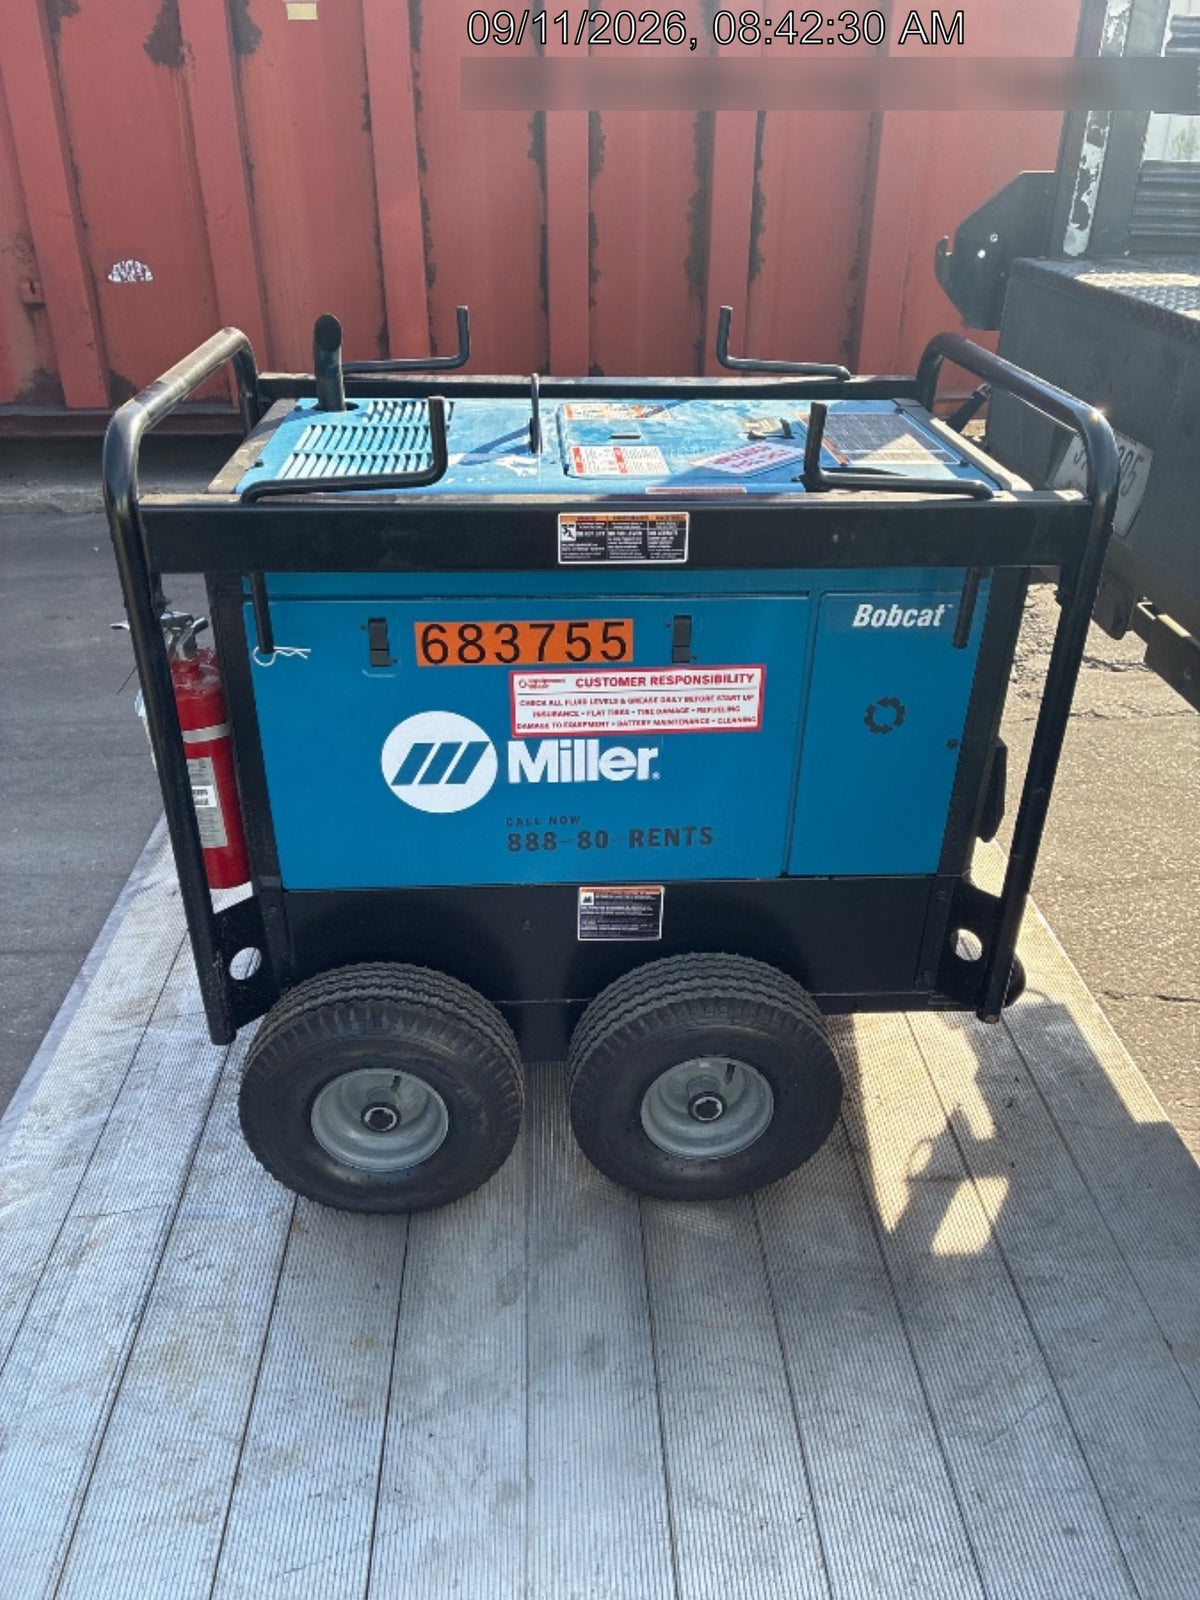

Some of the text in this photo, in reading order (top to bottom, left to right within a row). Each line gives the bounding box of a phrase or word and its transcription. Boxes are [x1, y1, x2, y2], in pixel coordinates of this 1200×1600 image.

[852, 603, 946, 628] Bobcat
[420, 621, 628, 665] 683755
[575, 677, 646, 688] CUSTOMER
[650, 673, 755, 686] RESPONSIBILITY
[684, 695, 715, 703] BEFORE
[716, 694, 741, 702] START
[533, 710, 579, 718] INSURANCE
[656, 707, 690, 715] DAMAGE
[696, 705, 740, 713] REFUELING
[563, 721, 609, 729] EQUIPMENT
[653, 718, 710, 726] MAINTENANCE
[717, 716, 756, 724] CLEANING
[505, 815, 581, 827] CALL NOW
